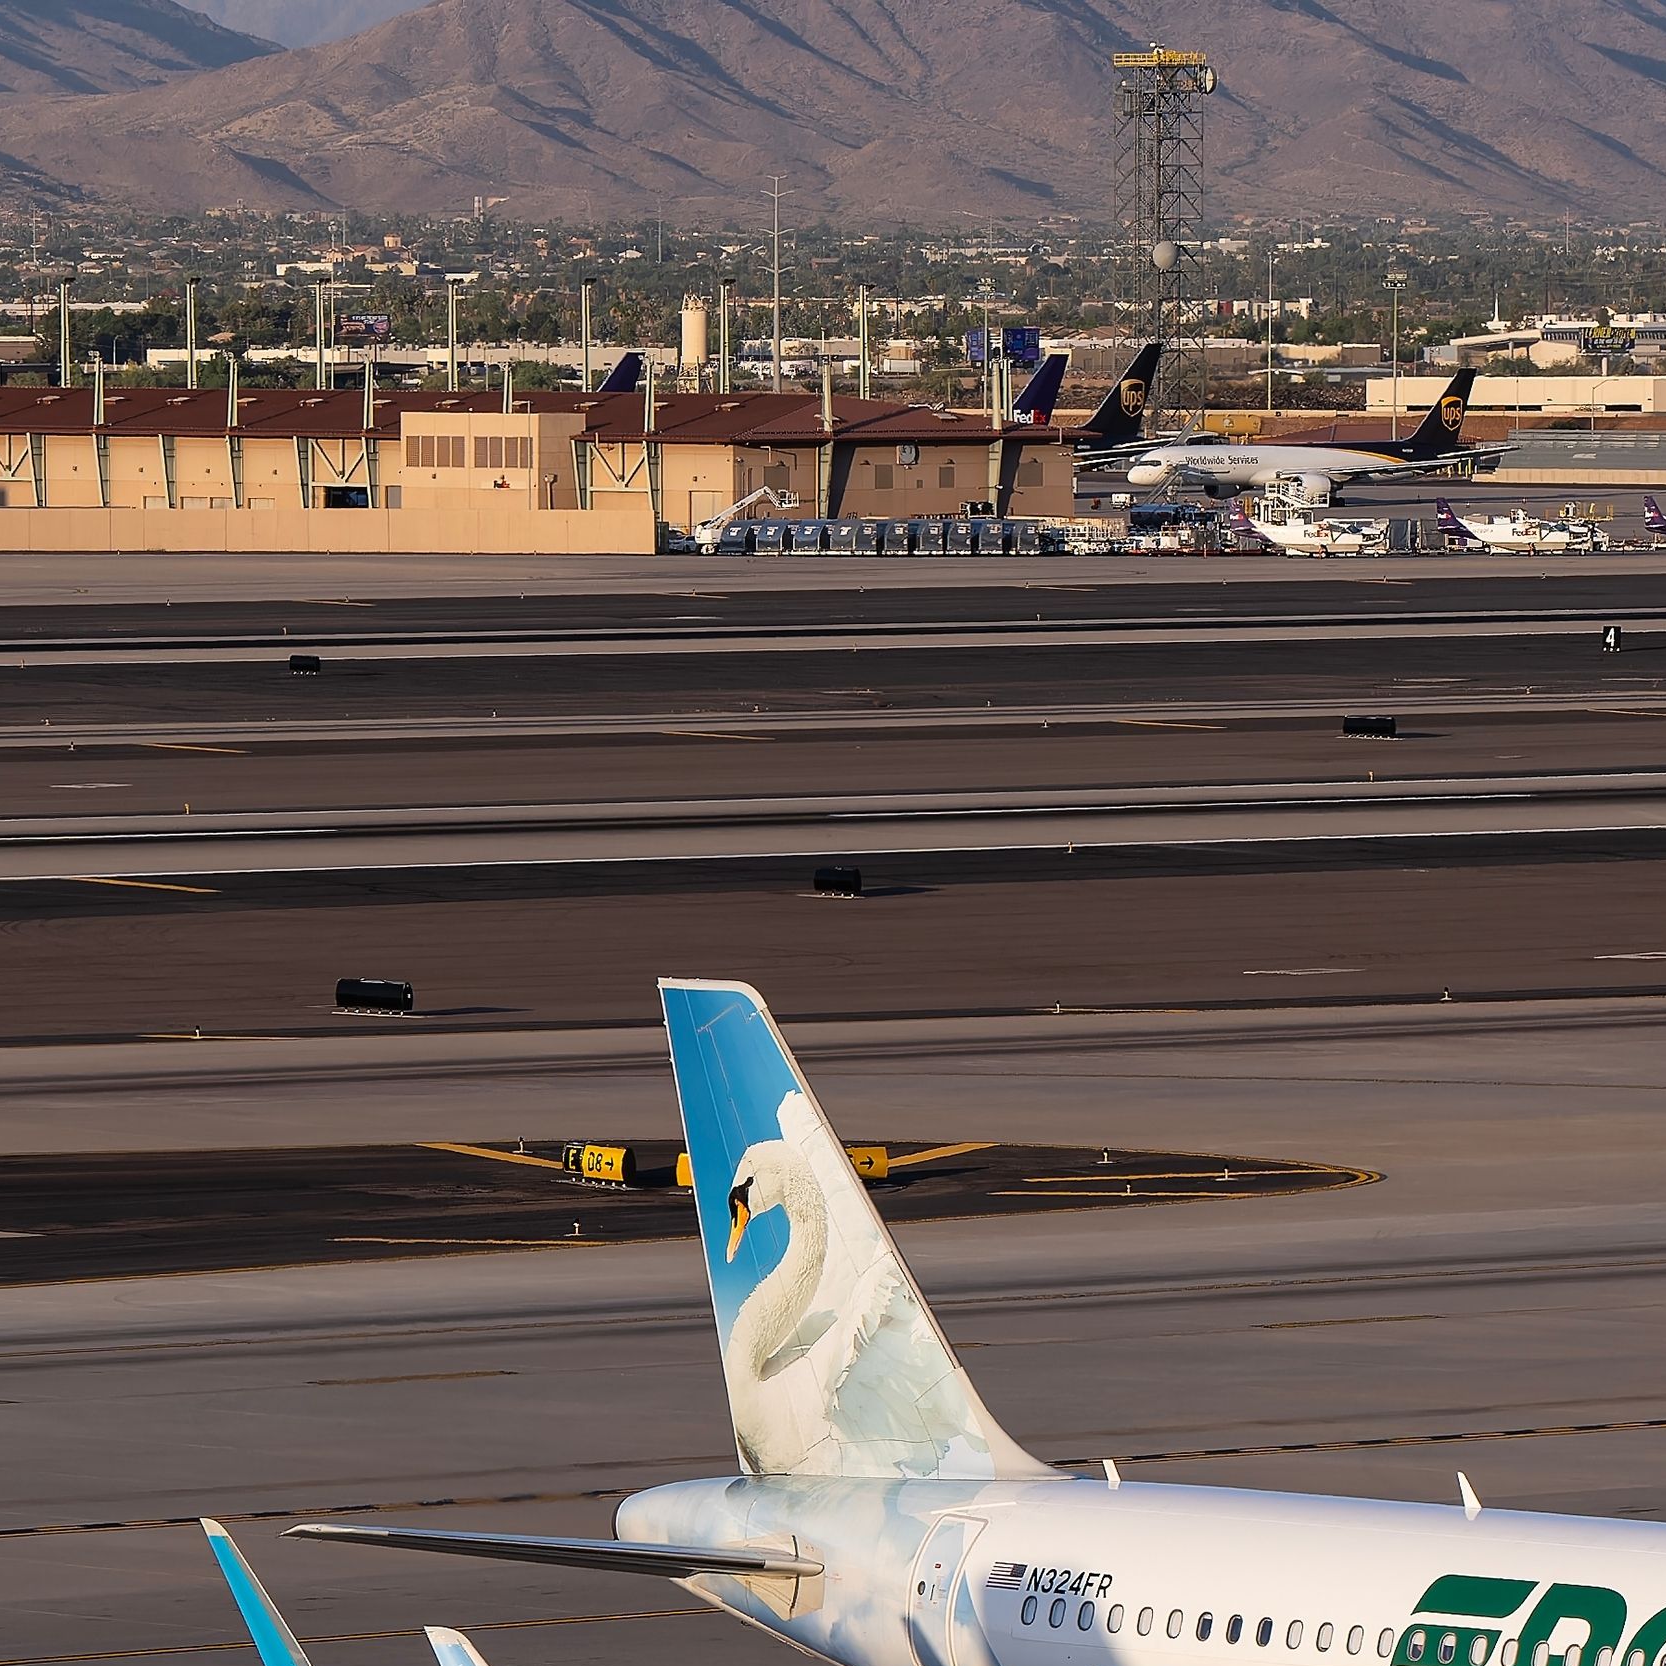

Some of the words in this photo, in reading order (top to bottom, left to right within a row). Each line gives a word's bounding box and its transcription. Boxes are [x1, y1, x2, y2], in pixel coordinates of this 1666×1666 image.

[1123, 391, 1143, 411] ups
[1014, 409, 1046, 425] FedEx
[1442, 406, 1462, 424] ups
[1185, 455, 1225, 465] Worldwide
[1228, 454, 1259, 465] Services
[1512, 528, 1537, 537] FedEx
[1605, 627, 1615, 647] 4
[568, 1149, 577, 1170] E
[587, 1151, 603, 1173] D8
[1025, 1566, 1113, 1600] N324FR
